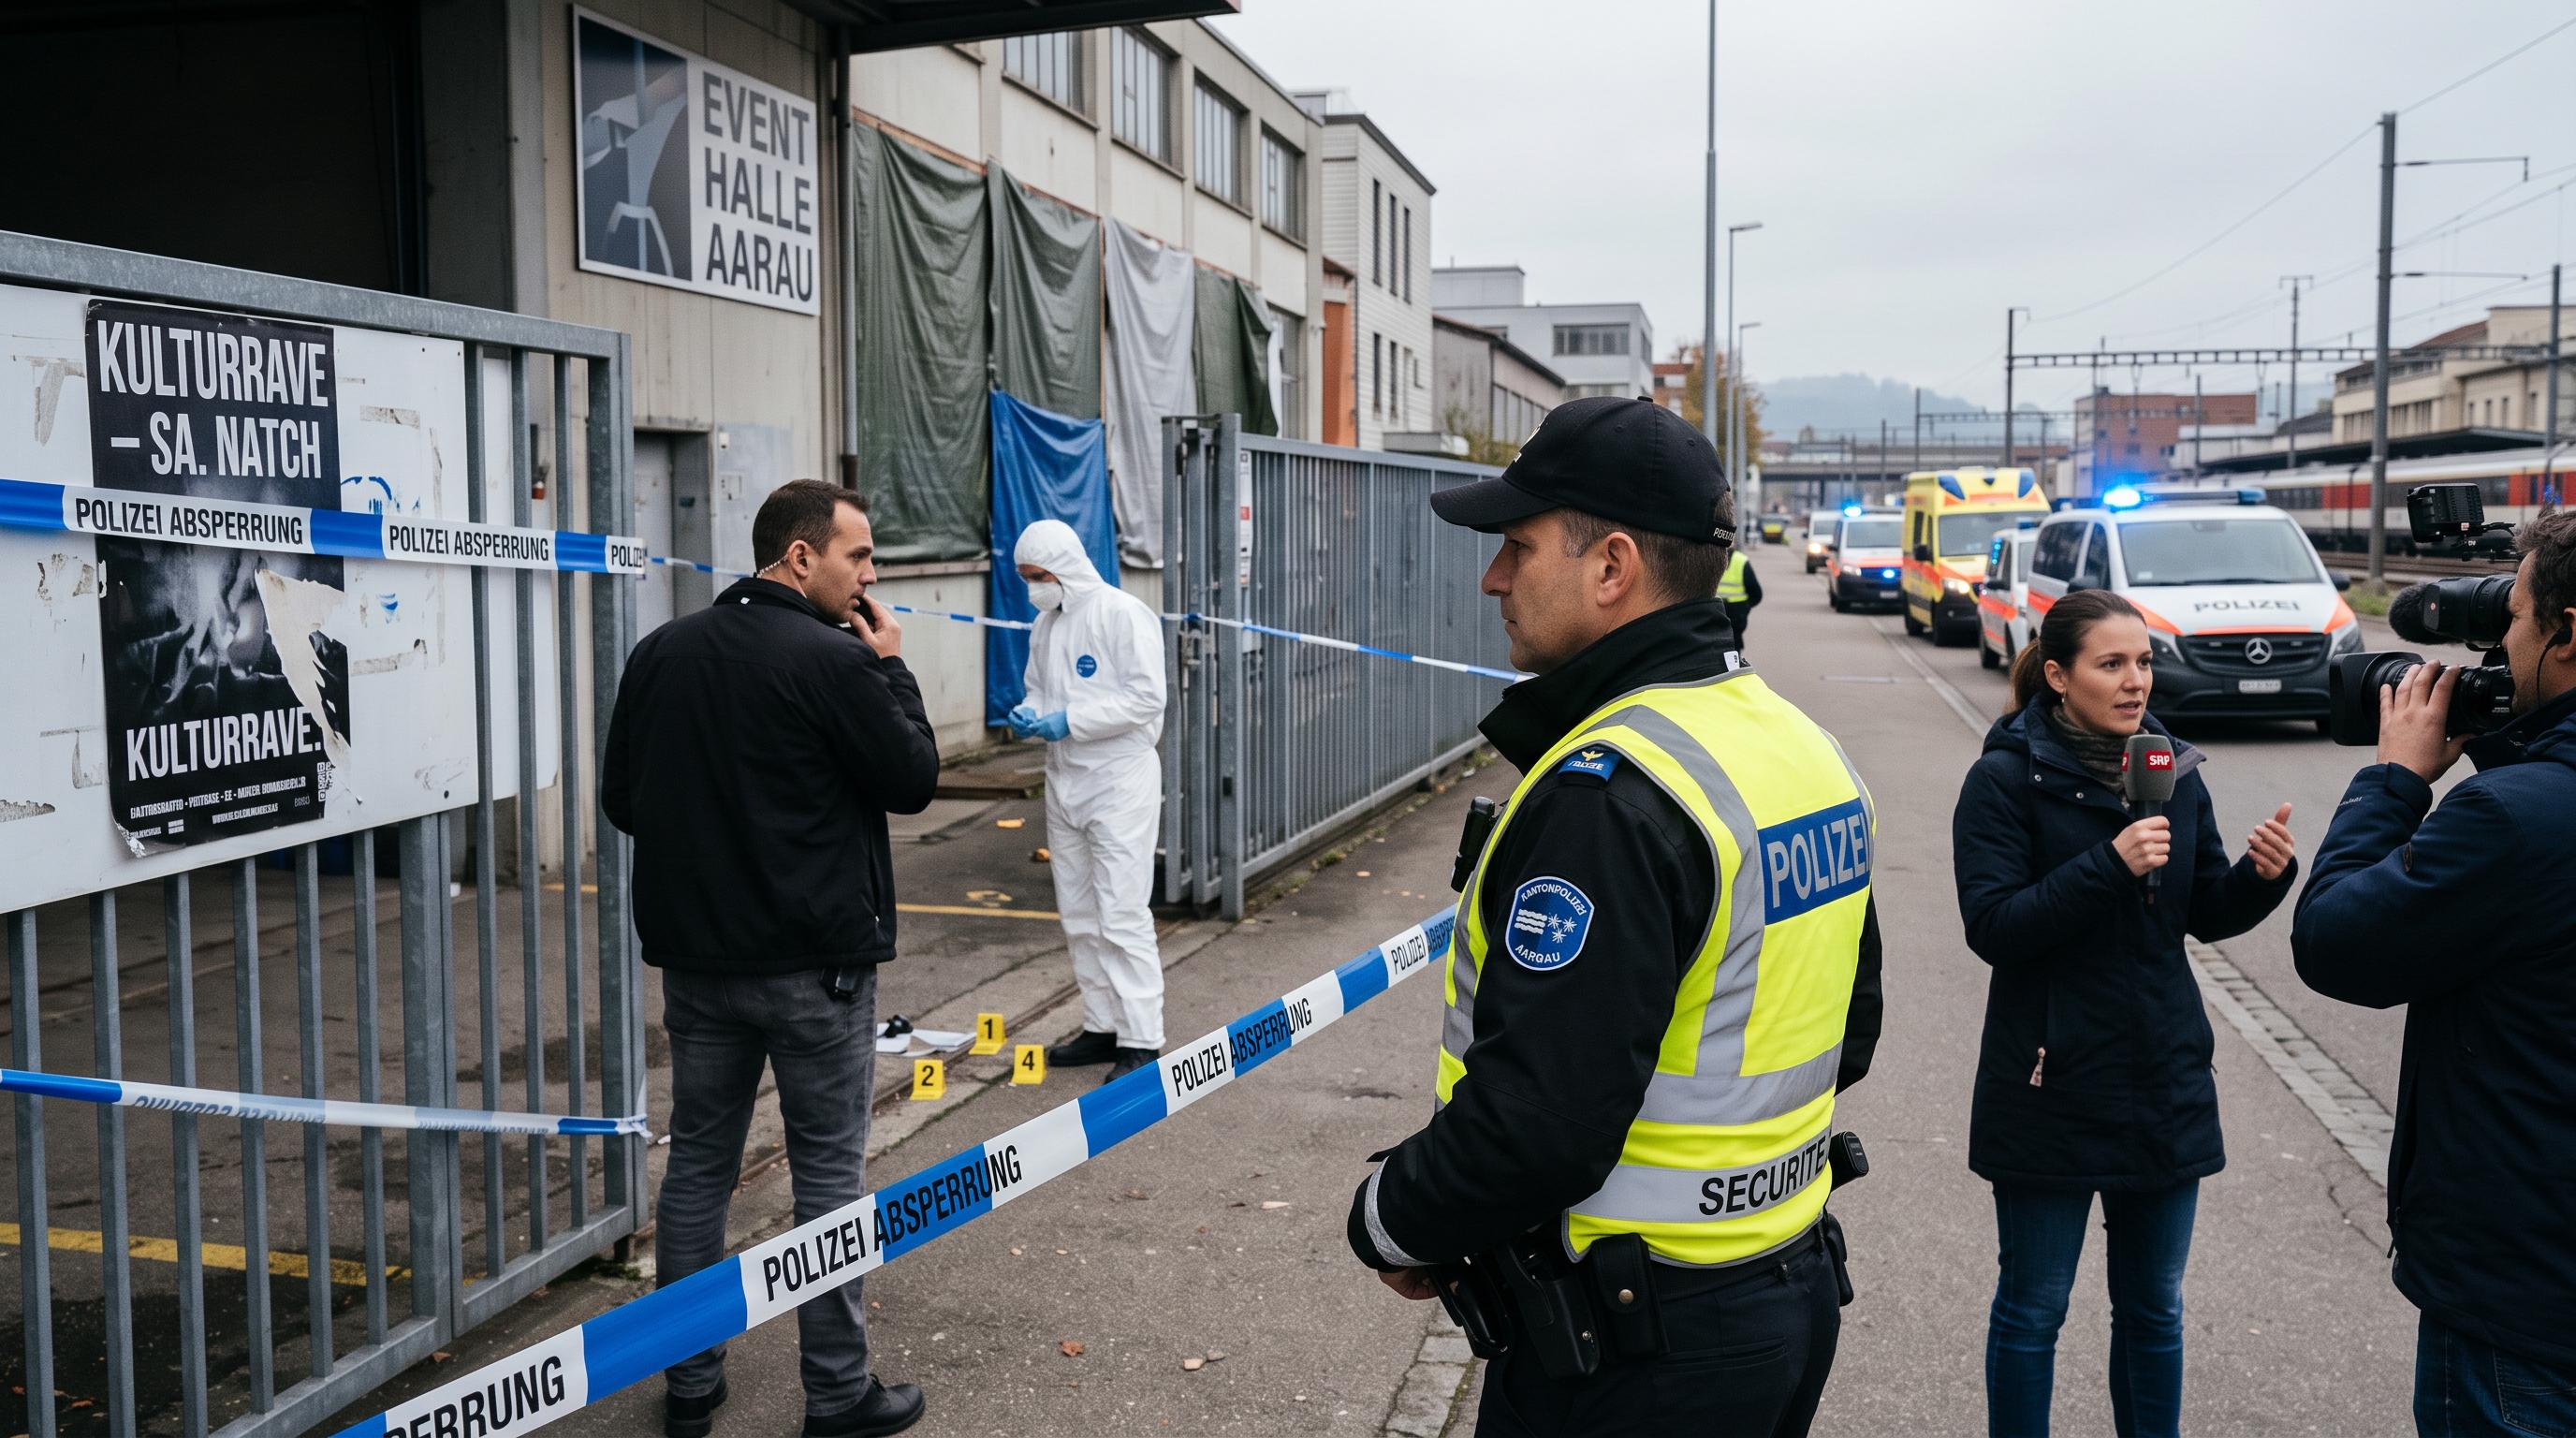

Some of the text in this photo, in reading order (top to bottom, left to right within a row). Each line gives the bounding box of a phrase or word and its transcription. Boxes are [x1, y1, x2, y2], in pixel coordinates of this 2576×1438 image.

[704, 70, 809, 167] EVENT
[705, 147, 812, 235] HALLE
[706, 223, 812, 302] AARAU
[97, 319, 328, 407] KULTURRAVE
[150, 411, 207, 476] SA.
[215, 415, 322, 478] NATCH
[76, 498, 303, 545] POLIZEI ABSPERRUNG
[389, 525, 549, 561] POLIZEI ABSPERRUNG
[2194, 599, 2301, 612] POLIZEI
[1766, 812, 1870, 908] POLIZEI
[1515, 944, 1560, 963] AARGAU
[984, 1019, 993, 1039] 1
[1022, 1050, 1035, 1071] 4
[1172, 997, 1312, 1097] POLIZEI ABSPERRUNG
[921, 1065, 934, 1086] 2
[763, 1145, 1022, 1302] POLIZEI ABSPERRUNG
[384, 1355, 565, 1438] RRUNG
